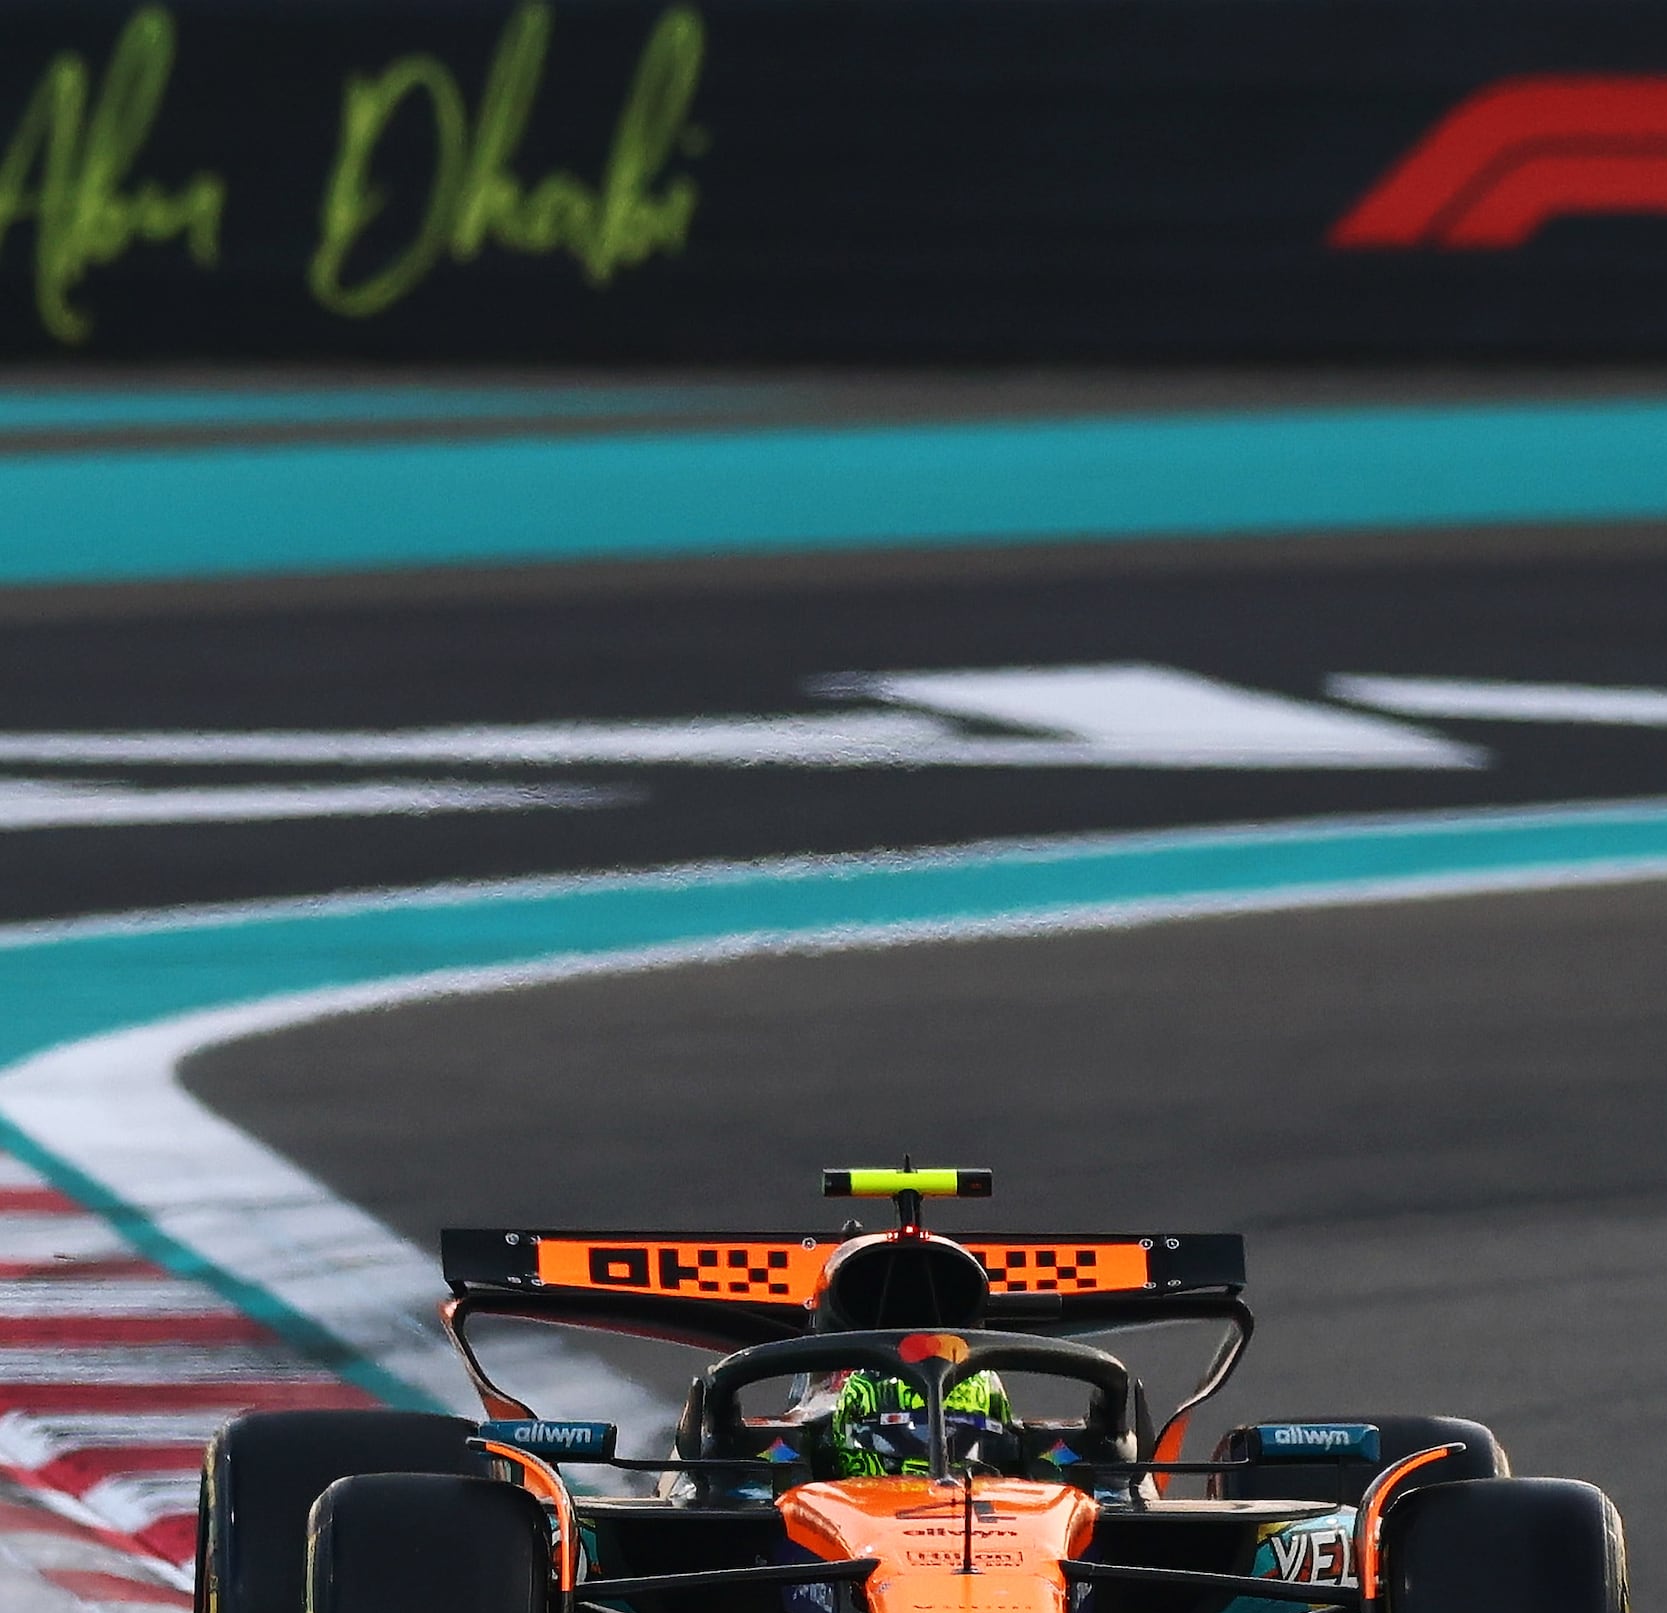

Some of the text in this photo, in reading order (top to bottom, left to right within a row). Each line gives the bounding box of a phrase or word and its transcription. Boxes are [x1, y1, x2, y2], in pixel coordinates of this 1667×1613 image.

[0, 2, 708, 344] Abu Dhabi
[589, 1247, 789, 1294] OKX
[514, 1422, 592, 1448] allwyn
[1274, 1424, 1350, 1451] allwyn
